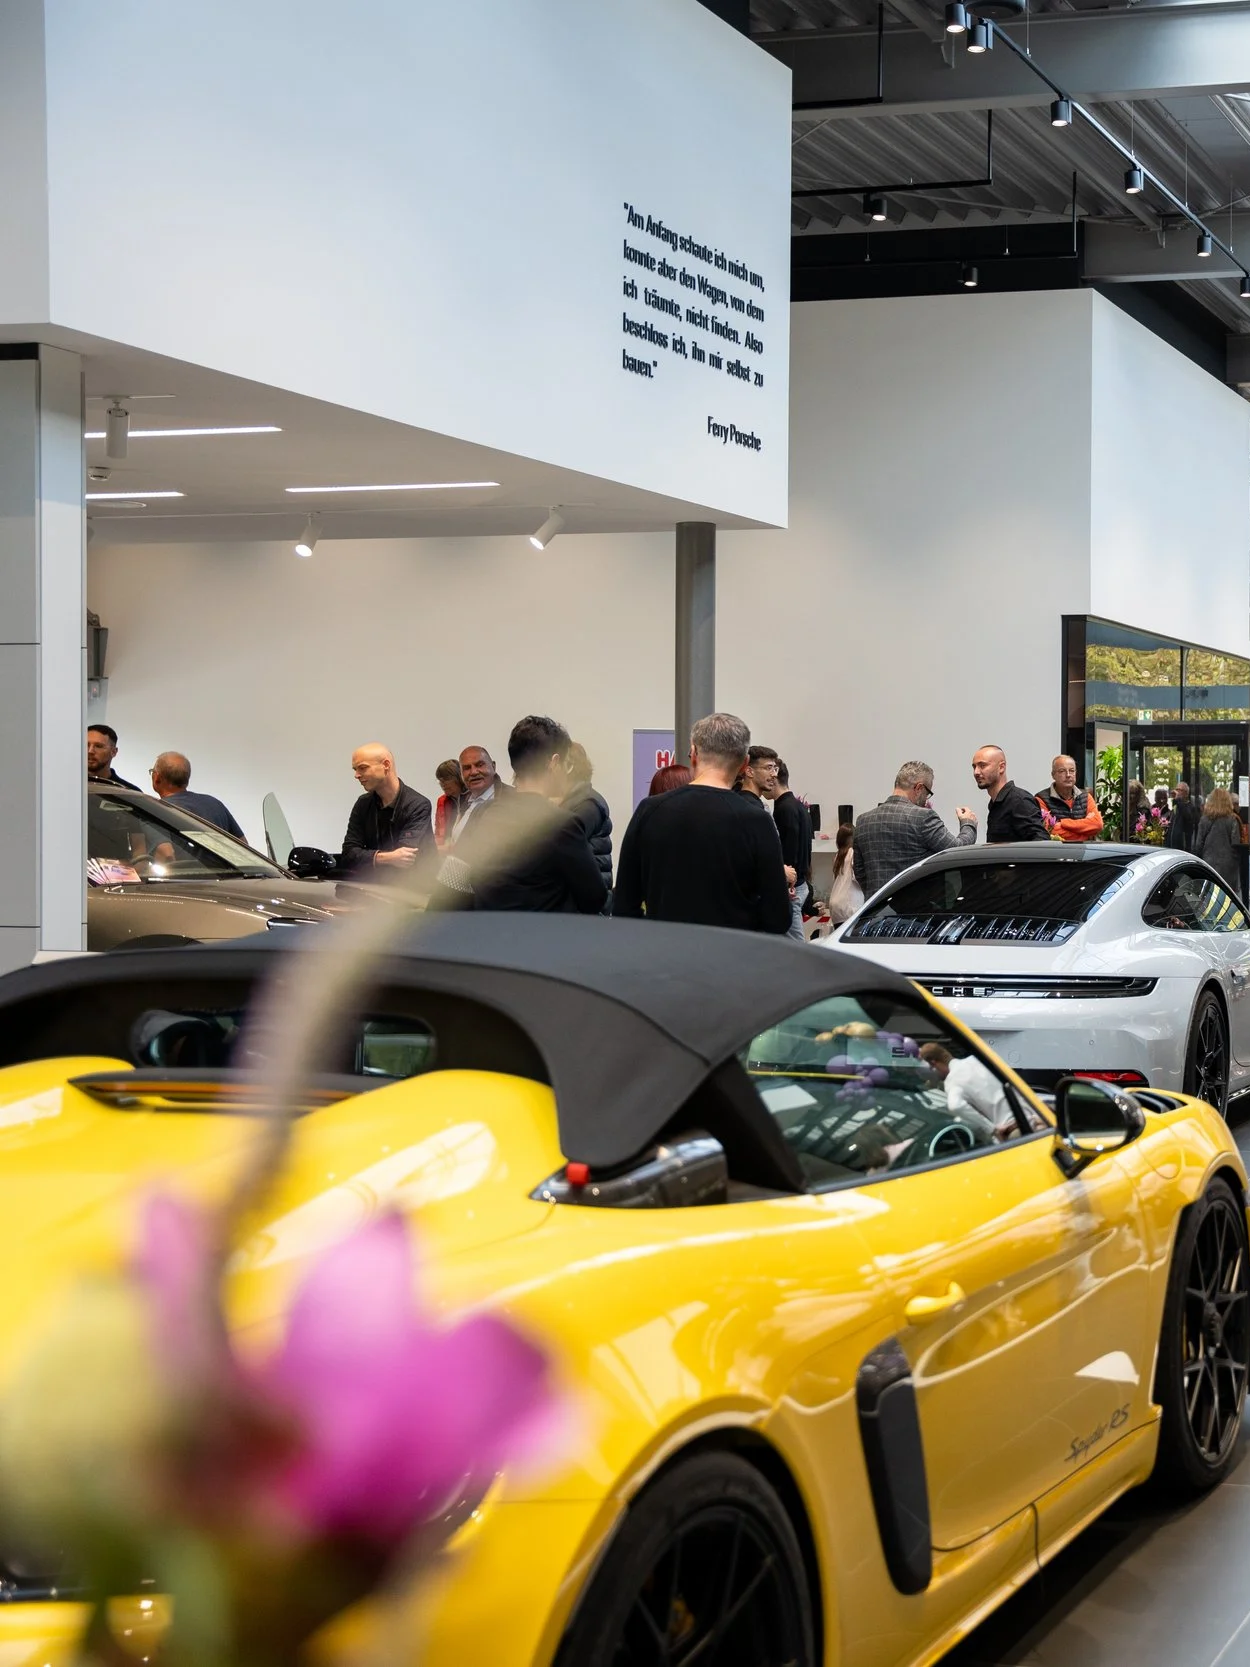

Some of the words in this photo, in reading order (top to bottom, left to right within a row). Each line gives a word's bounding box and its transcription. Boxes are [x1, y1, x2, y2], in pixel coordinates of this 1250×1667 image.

[623, 239, 656, 272] konnte
[657, 257, 678, 282] aber
[679, 267, 696, 291] den
[697, 274, 729, 309] Wagen,
[730, 295, 745, 314] von
[746, 299, 764, 322] dem
[645, 214, 678, 252] Anfang
[679, 235, 713, 265] schaute
[714, 248, 727, 272] ich
[728, 259, 748, 282] mich
[749, 271, 765, 293] um,
[622, 312, 668, 349] beschloss
[672, 332, 688, 359] ich,
[691, 341, 705, 364] ihn
[709, 351, 723, 370] mir
[726, 359, 751, 383] selbst
[754, 372, 763, 387] zu
[623, 275, 638, 300] ich
[643, 287, 682, 322] träumte,
[686, 306, 710, 331] nicht
[711, 315, 741, 345] finden.
[744, 331, 763, 354] Also
[707, 416, 729, 444] Ferry
[730, 423, 761, 452] Porsche
[1108, 1403, 1131, 1433] RS
